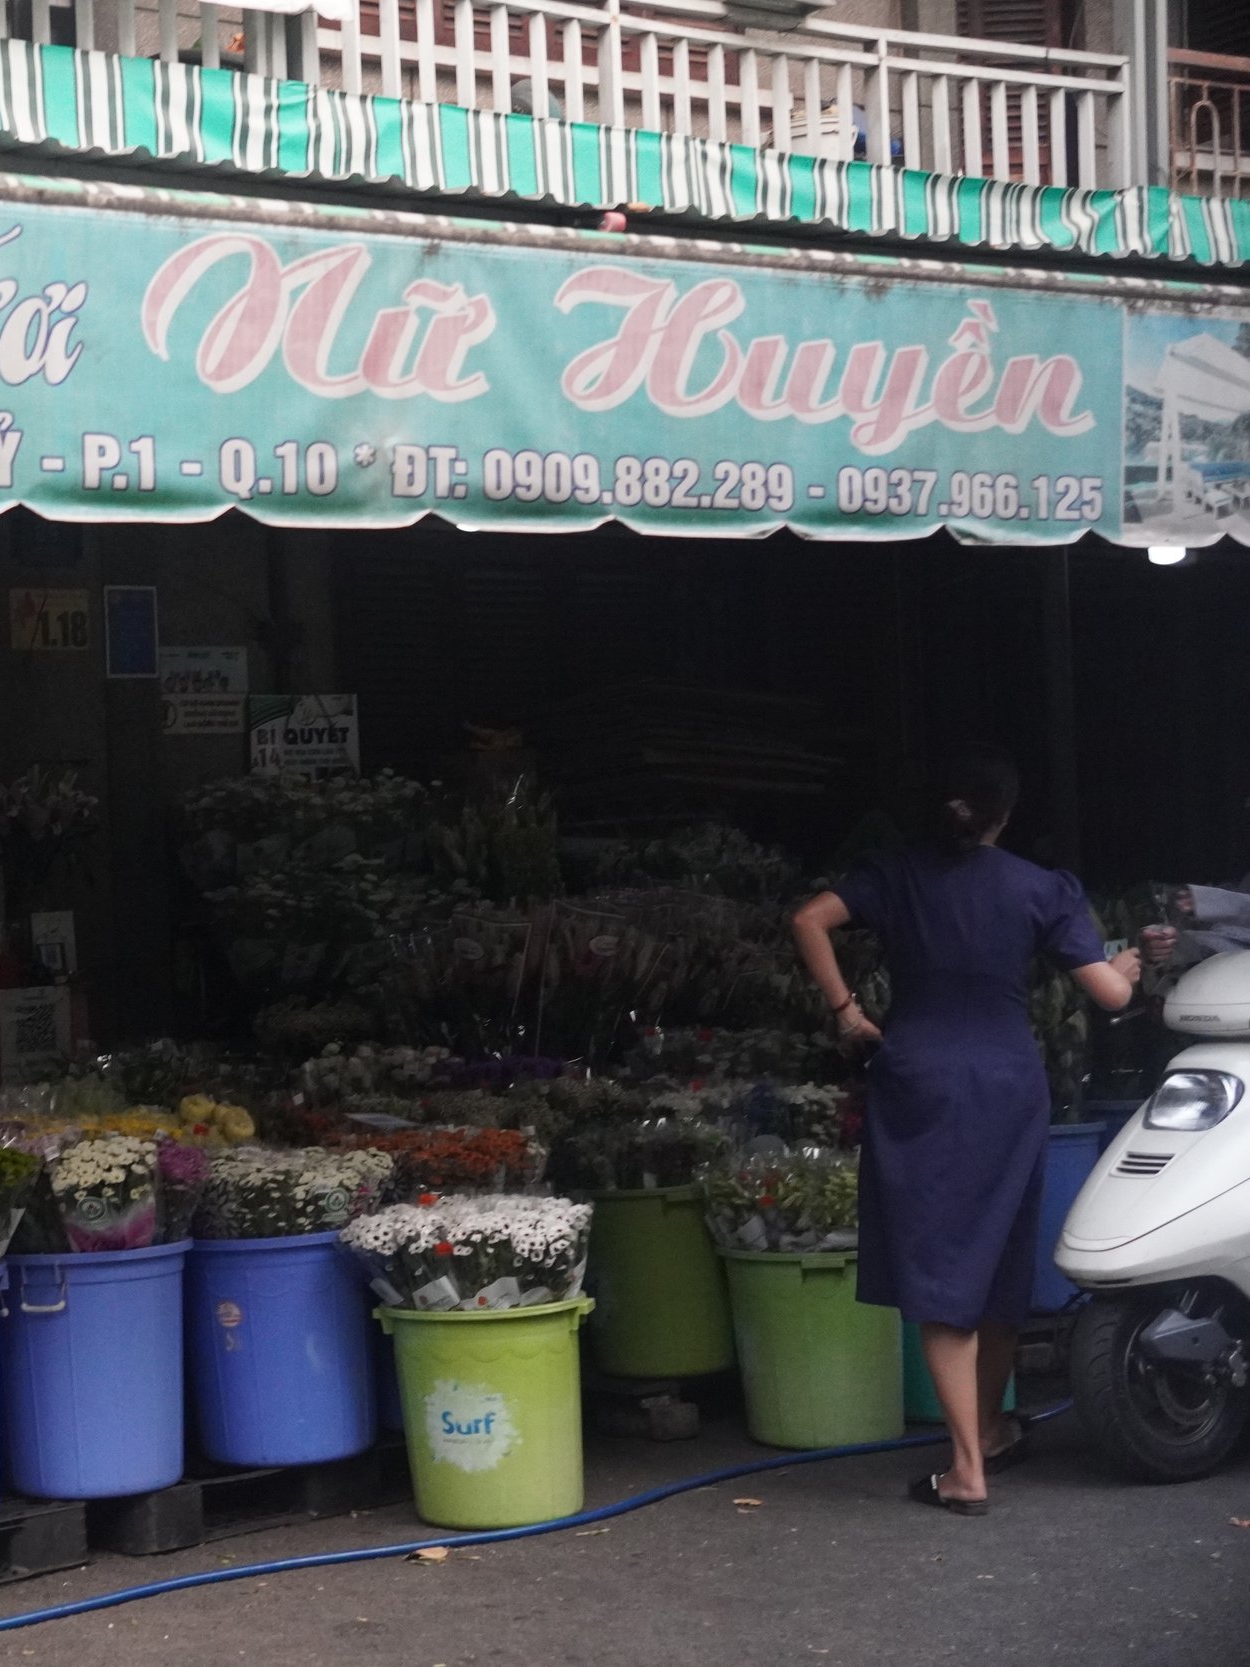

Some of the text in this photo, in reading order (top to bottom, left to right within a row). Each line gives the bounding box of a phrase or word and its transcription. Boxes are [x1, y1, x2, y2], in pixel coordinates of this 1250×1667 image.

[554, 265, 1098, 456] Huyền
[41, 454, 66, 473] -
[83, 434, 156, 491] P.1
[180, 459, 203, 476] -
[219, 437, 338, 499] Q.10
[390, 445, 468, 500] ĐT:
[484, 448, 794, 513] 0909.882.289
[807, 484, 825, 500] -
[837, 465, 1103, 522] 0937.966.125
[441, 1410, 497, 1435] Surf
